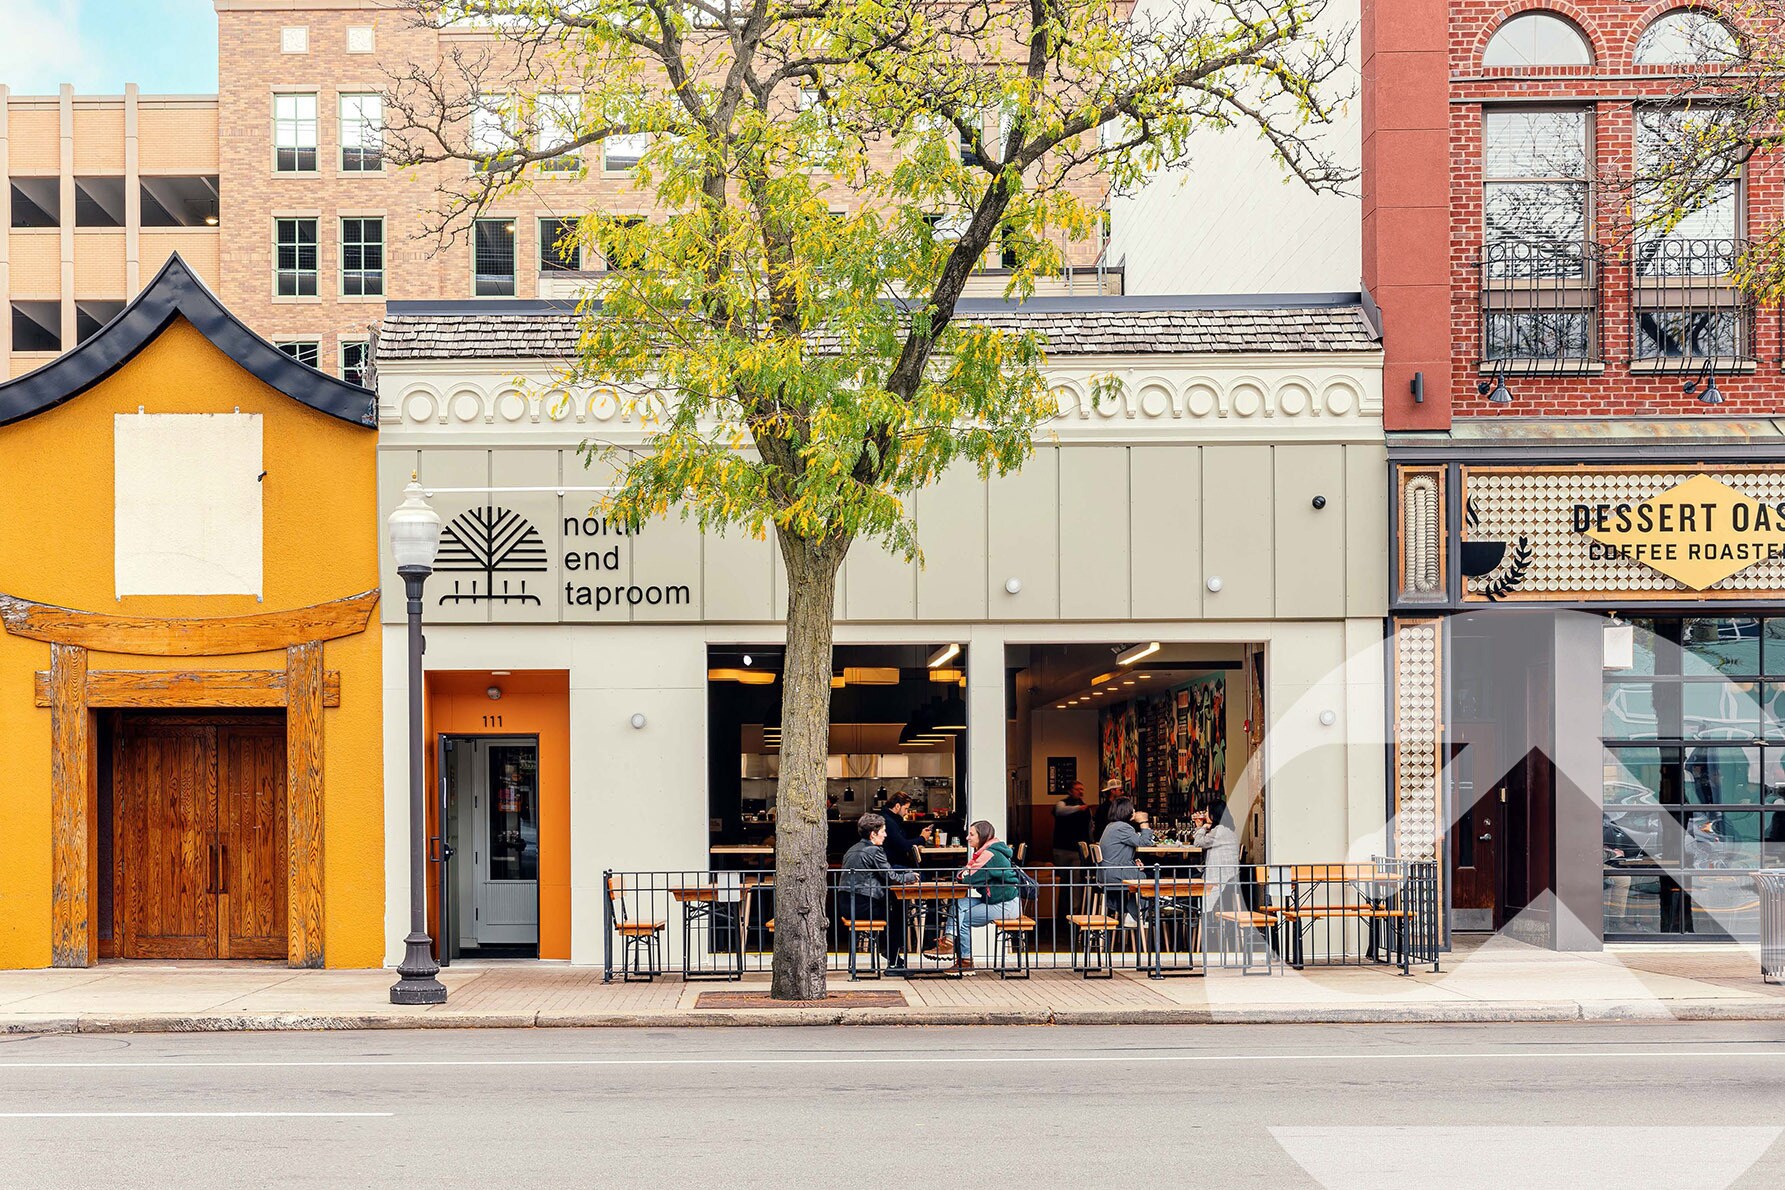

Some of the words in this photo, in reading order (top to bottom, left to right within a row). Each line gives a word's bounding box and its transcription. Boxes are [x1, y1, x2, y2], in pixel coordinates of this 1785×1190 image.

[1573, 502, 1717, 533] DESSERT
[1732, 502, 1785, 532] OAS
[564, 546, 620, 571] end
[1588, 543, 1678, 561] COFFEE
[1688, 543, 1785, 560] ROASTE
[565, 581, 690, 611] taproom
[482, 715, 503, 728] 111
